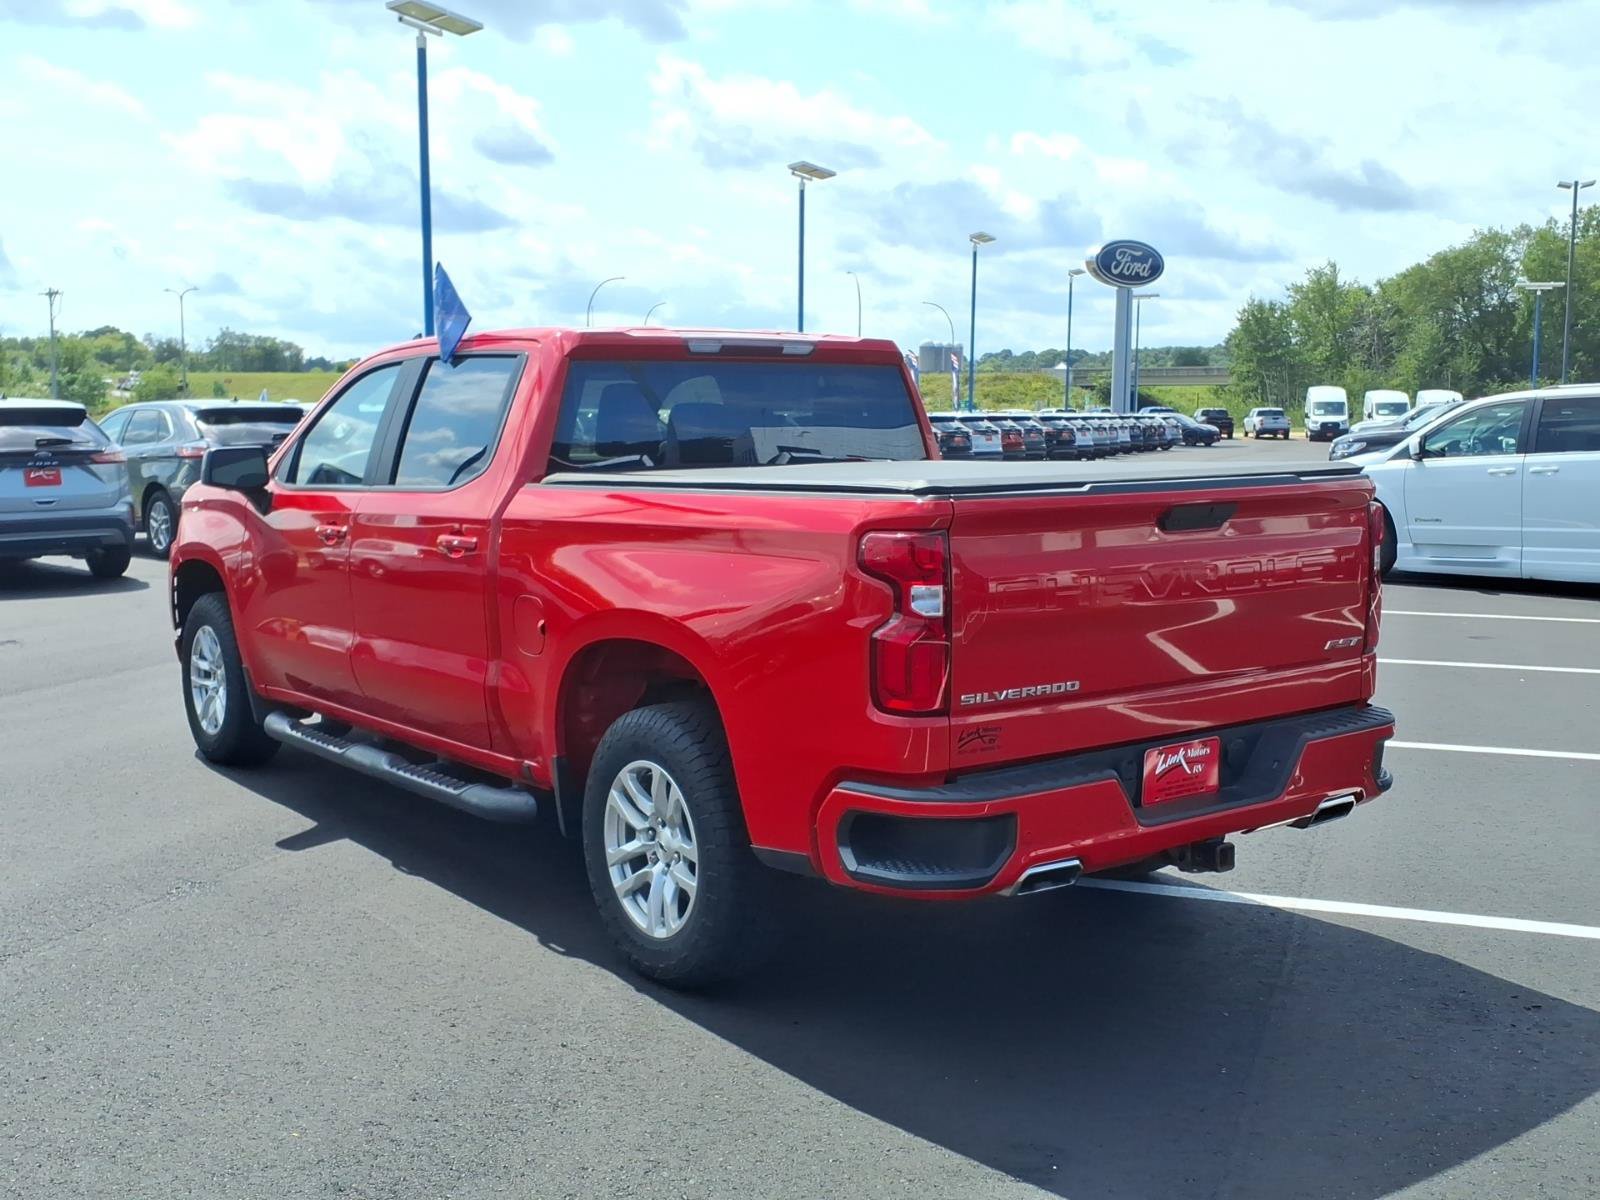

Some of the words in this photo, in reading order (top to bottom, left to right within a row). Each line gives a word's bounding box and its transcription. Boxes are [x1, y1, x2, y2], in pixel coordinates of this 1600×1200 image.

[1111, 248, 1152, 277] Ford
[1324, 636, 1362, 650] RST
[960, 680, 1080, 705] SILVERADO
[1155, 747, 1191, 775] Link
[1187, 747, 1210, 758] Motors
[1193, 763, 1204, 774] RV
